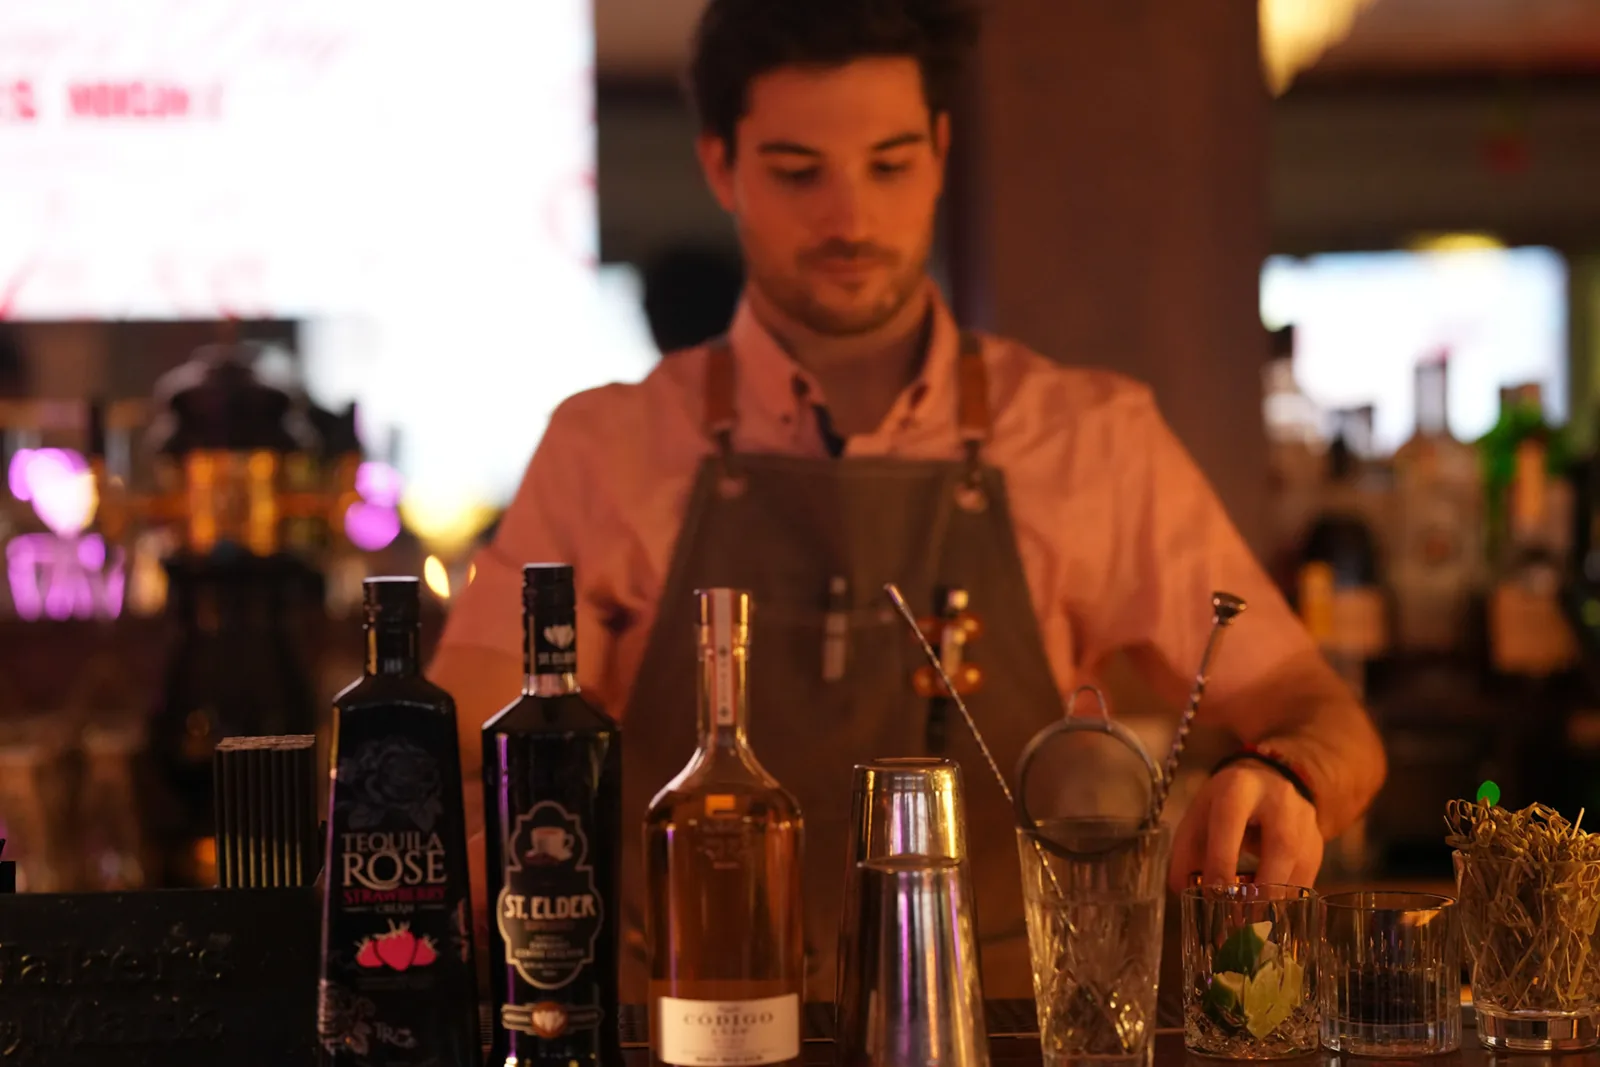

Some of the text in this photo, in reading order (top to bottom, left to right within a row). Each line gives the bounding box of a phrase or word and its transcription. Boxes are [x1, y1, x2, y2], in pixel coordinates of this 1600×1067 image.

[340, 830, 444, 852] TEQUILA
[341, 849, 448, 891] ROSE
[503, 893, 596, 920] ST. ELDER
